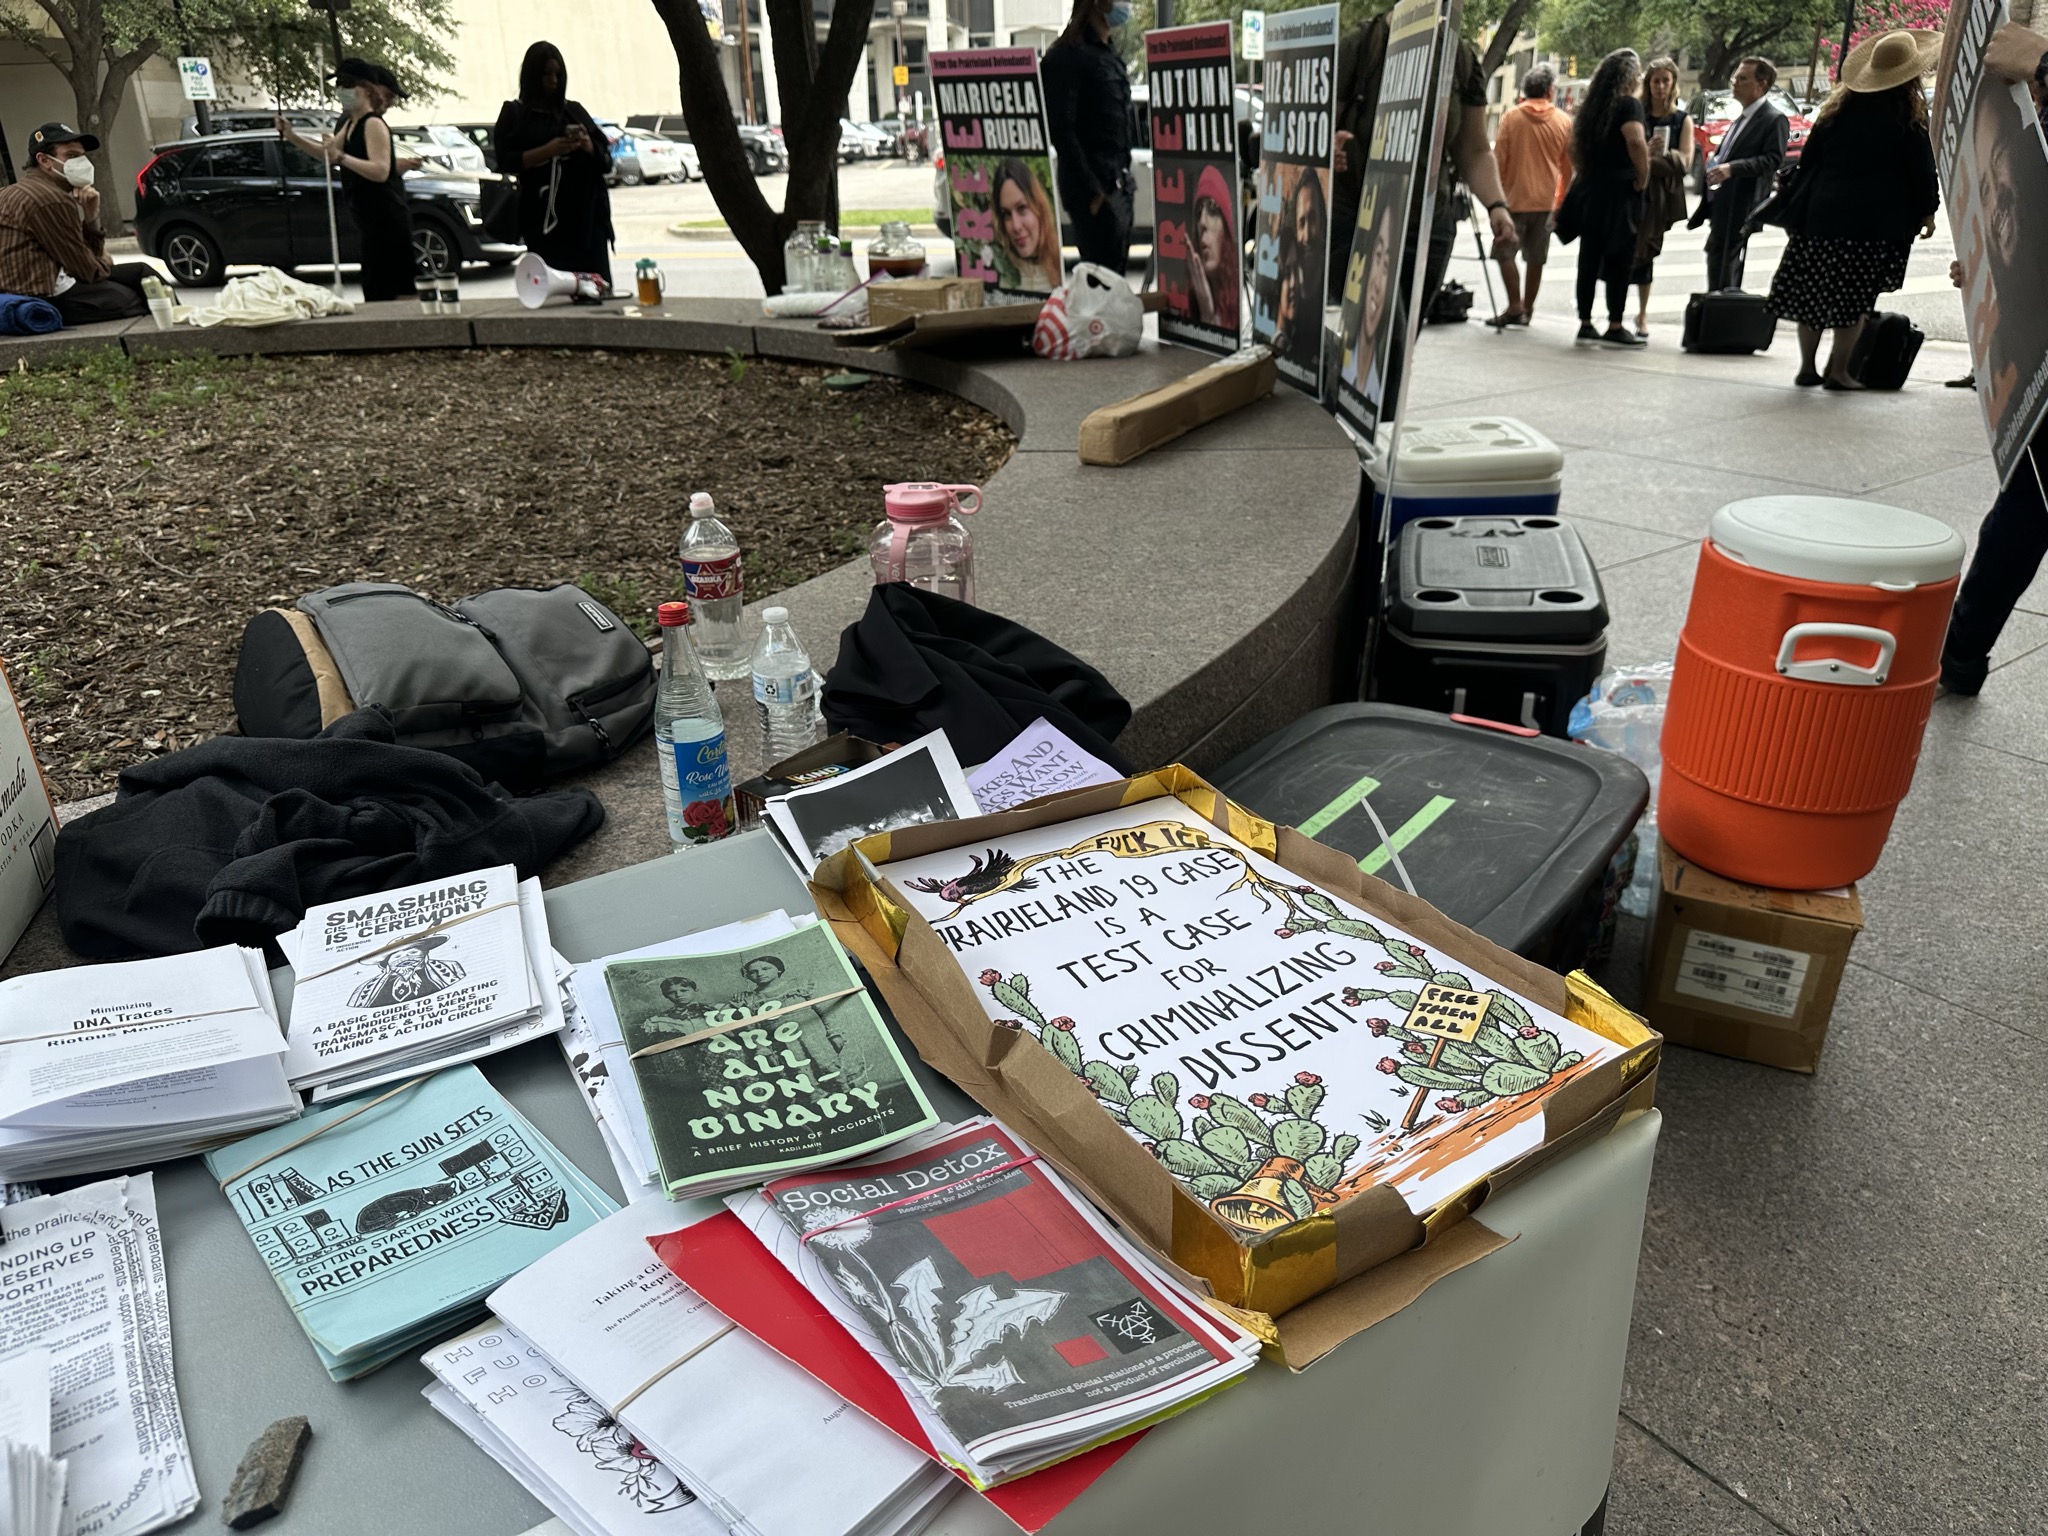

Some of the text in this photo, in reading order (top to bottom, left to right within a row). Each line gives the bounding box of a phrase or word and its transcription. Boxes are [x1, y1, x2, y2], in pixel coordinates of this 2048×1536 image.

[938, 81, 1039, 114] MARICELA
[1151, 66, 1231, 108] AUTUMN
[1265, 56, 1330, 105] LIZ & INES
[983, 118, 1044, 150] RUEDA
[1185, 112, 1234, 152] HILL
[1287, 110, 1329, 158] SOTO
[1384, 108, 1418, 163] SONG
[943, 118, 999, 283] FREE
[792, 765, 841, 780] KIND
[1007, 750, 1070, 790] WANT
[1010, 740, 1054, 776] AND
[0, 756, 27, 816] made
[686, 771, 714, 785] Rose
[1020, 761, 1084, 799] KNOW
[19, 821, 37, 847] TEXAS
[1096, 828, 1212, 854] FUCK ICE
[1037, 857, 1103, 885] THE
[324, 891, 489, 935] CIS-HETEROPATRIARCHY
[326, 880, 488, 927] SMASHING
[934, 851, 1240, 952] PRAIRIELAND 19 CASE
[325, 898, 487, 946] IS CEREMONY
[1094, 907, 1167, 938] IS A
[1056, 908, 1253, 989] TEST CASE
[1160, 958, 1227, 990] FOR
[91, 1001, 152, 1015] Minimizing
[312, 979, 498, 1034] A BASIC GUIDE TO STARTING
[402, 1017, 413, 1026] &
[420, 994, 498, 1021] TWO-SPIRIT
[1098, 942, 1357, 1061] CRIMINALIZING
[1418, 1003, 1477, 1021] THEM
[1427, 988, 1479, 1005] FREE
[73, 1006, 173, 1030] DNA Traces
[317, 1003, 493, 1057] TALKING & ACTION CIRCLE
[332, 1025, 350, 1037] AN
[356, 1007, 434, 1030] INDIGENOUS
[1413, 1016, 1463, 1033] ALL
[47, 1032, 117, 1047] Riotous
[1179, 992, 1358, 1090] DISSENT
[326, 1105, 494, 1192] AS THE SUN SETS
[693, 1108, 896, 1157] A BRIEF HISTORY OF ACCIDENTS
[782, 1142, 1008, 1214] Social Detox
[898, 1199, 942, 1215] Resources
[943, 1195, 956, 1203] for
[957, 1178, 1003, 1199] Anti-Sexist
[1004, 1168, 1022, 1181] Men
[6, 1227, 31, 1241] the
[70, 1230, 96, 1247] UP
[296, 1245, 367, 1279] GETTING
[370, 1216, 436, 1249] STARTED
[438, 1196, 481, 1222] WITH
[300, 1206, 495, 1297] PREPAREDNESS
[145, 1226, 164, 1284] defendants
[26, 1286, 106, 1318] PRAIRIELAND ICE
[44, 1291, 73, 1305] DEMO
[53, 1281, 83, 1295] STATE
[85, 1273, 105, 1284] AND
[592, 1279, 638, 1306] Taking
[11, 1319, 68, 1343] ALLEGEDLY
[70, 1303, 109, 1323] BECAME
[13, 1297, 109, 1335] OFFICER WITH THE
[54, 1295, 97, 1314] ON JULY
[118, 1294, 136, 1328] support
[603, 1286, 675, 1333] The Prison Strike and
[123, 1328, 135, 1342] the
[122, 1341, 143, 1389] prairieland
[1004, 1383, 1075, 1408] Transforming
[1074, 1375, 1104, 1391] Social
[1104, 1363, 1145, 1382] relations
[1145, 1359, 1153, 1367] is
[1085, 1389, 1103, 1398] not
[1104, 1385, 1112, 1393] a
[1112, 1374, 1149, 1393] product
[1149, 1367, 1160, 1376] of
[130, 1389, 152, 1455] defendants
[822, 1402, 849, 1424] August
